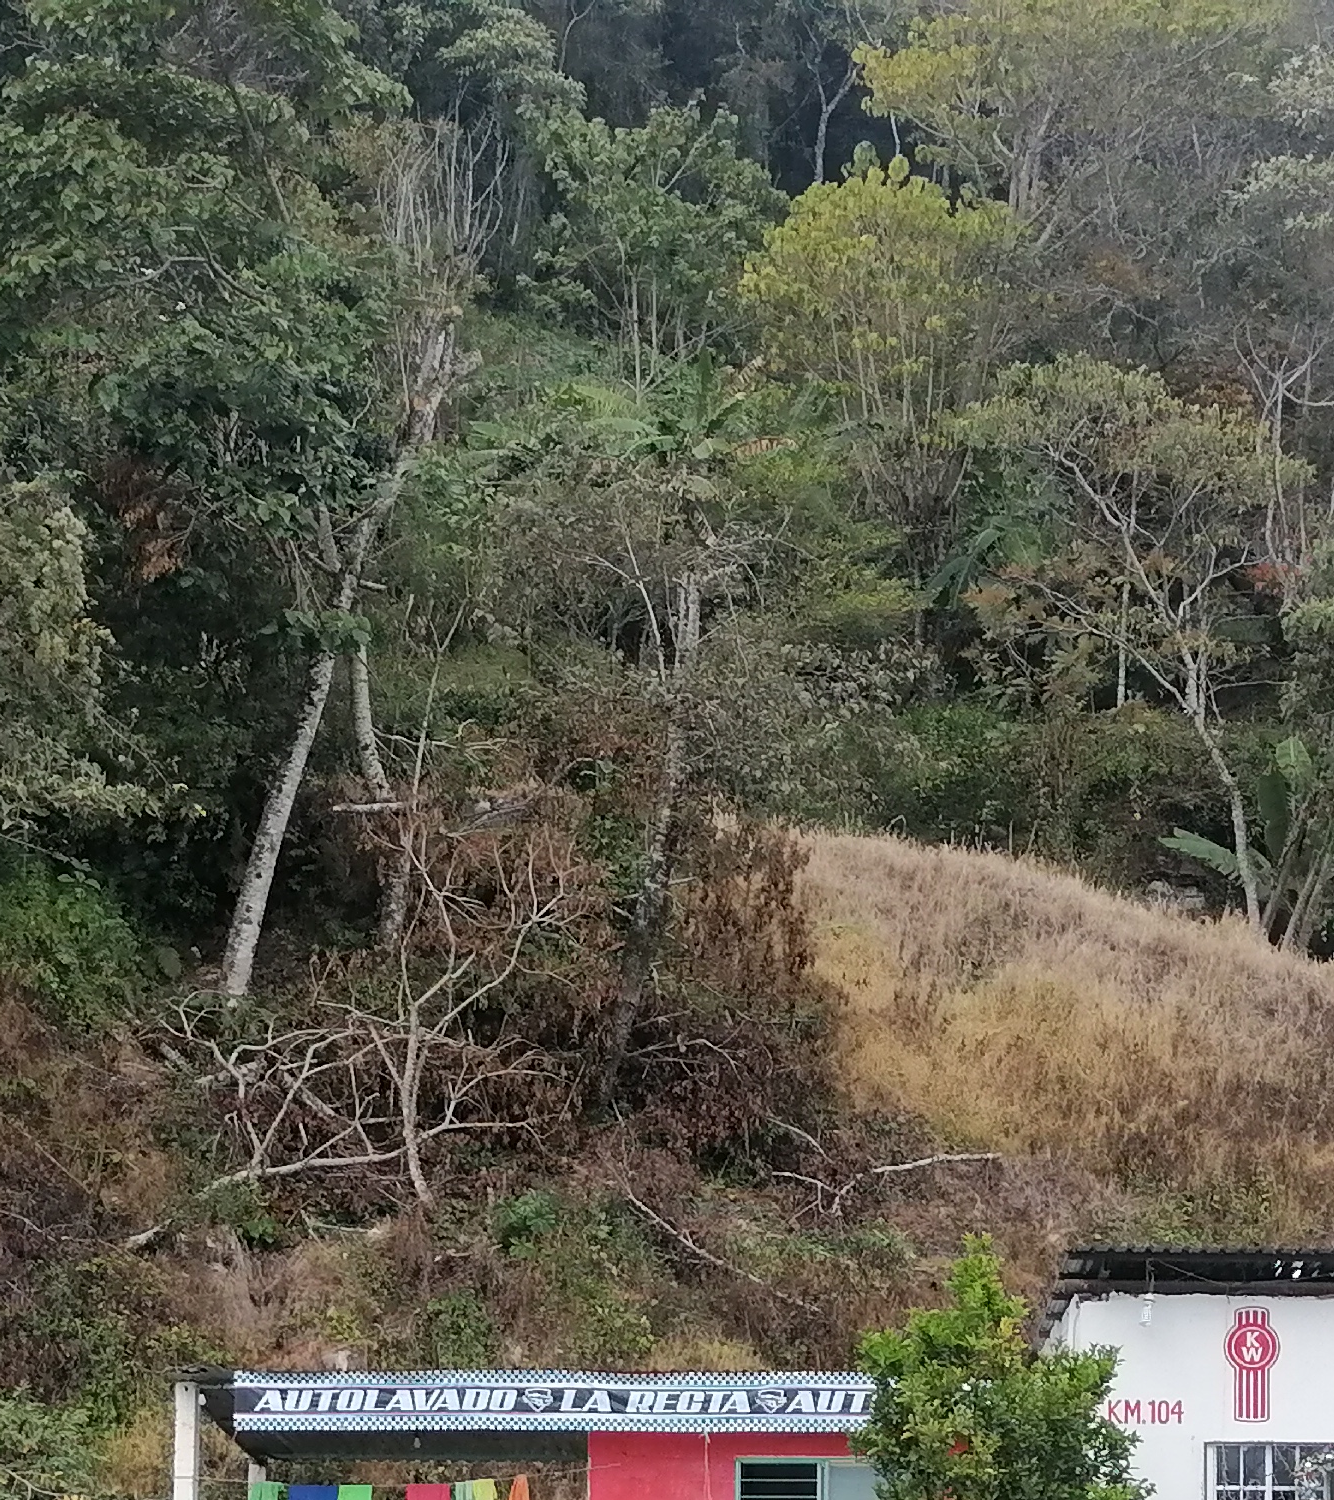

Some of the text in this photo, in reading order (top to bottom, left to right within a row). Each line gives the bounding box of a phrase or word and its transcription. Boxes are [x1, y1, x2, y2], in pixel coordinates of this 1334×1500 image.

[254, 1388, 518, 1412] AUTOLAVADO
[559, 1389, 612, 1412] LA
[625, 1390, 751, 1413] RECTA
[1107, 1399, 1184, 1425] KM.104
